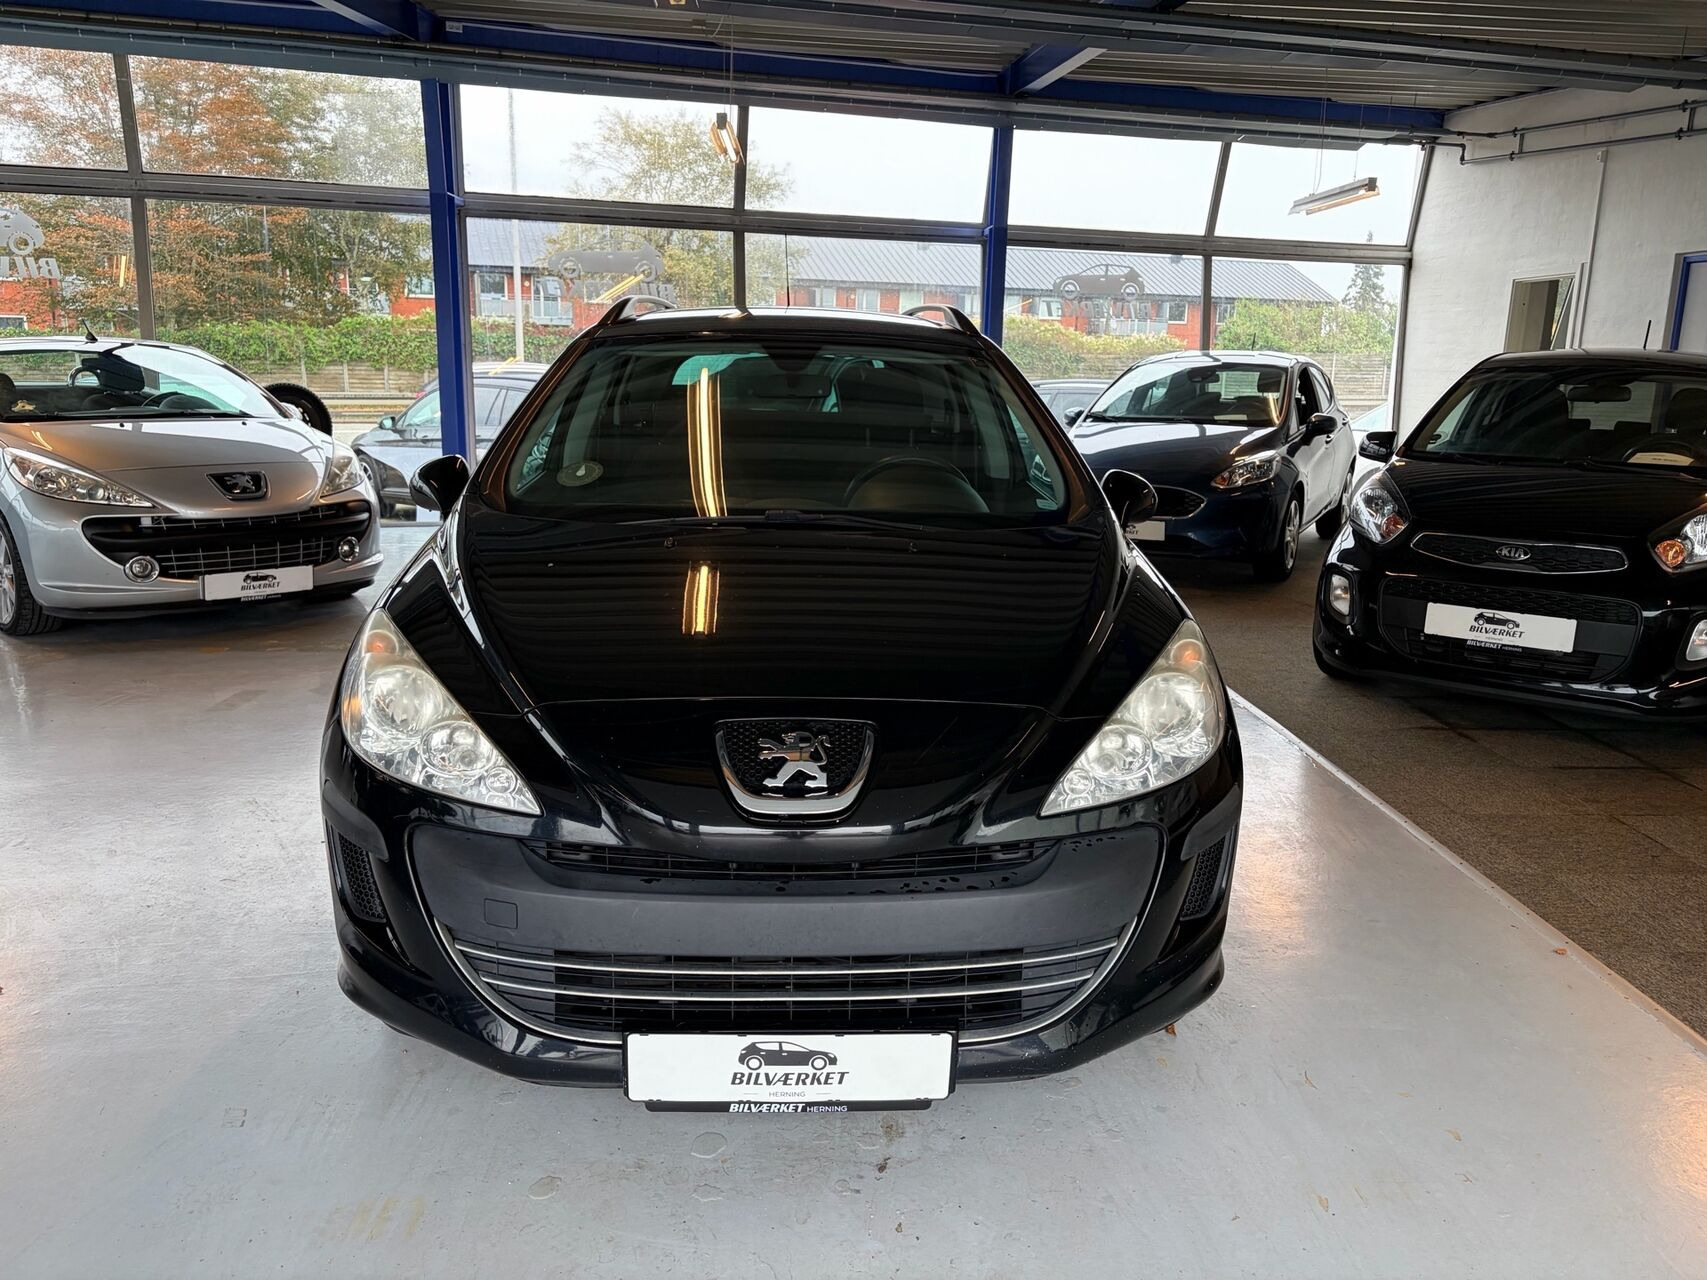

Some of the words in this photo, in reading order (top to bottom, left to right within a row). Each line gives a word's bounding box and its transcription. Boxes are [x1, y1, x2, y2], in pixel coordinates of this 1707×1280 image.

[1501, 547, 1525, 559] KIA
[240, 581, 281, 591] BILVÆRKET
[1469, 624, 1525, 640] BILVÆRKET
[730, 1071, 849, 1087] BILVÆRKET
[728, 1103, 805, 1113] BILVÆRKET
[806, 1105, 848, 1113] HERNING
